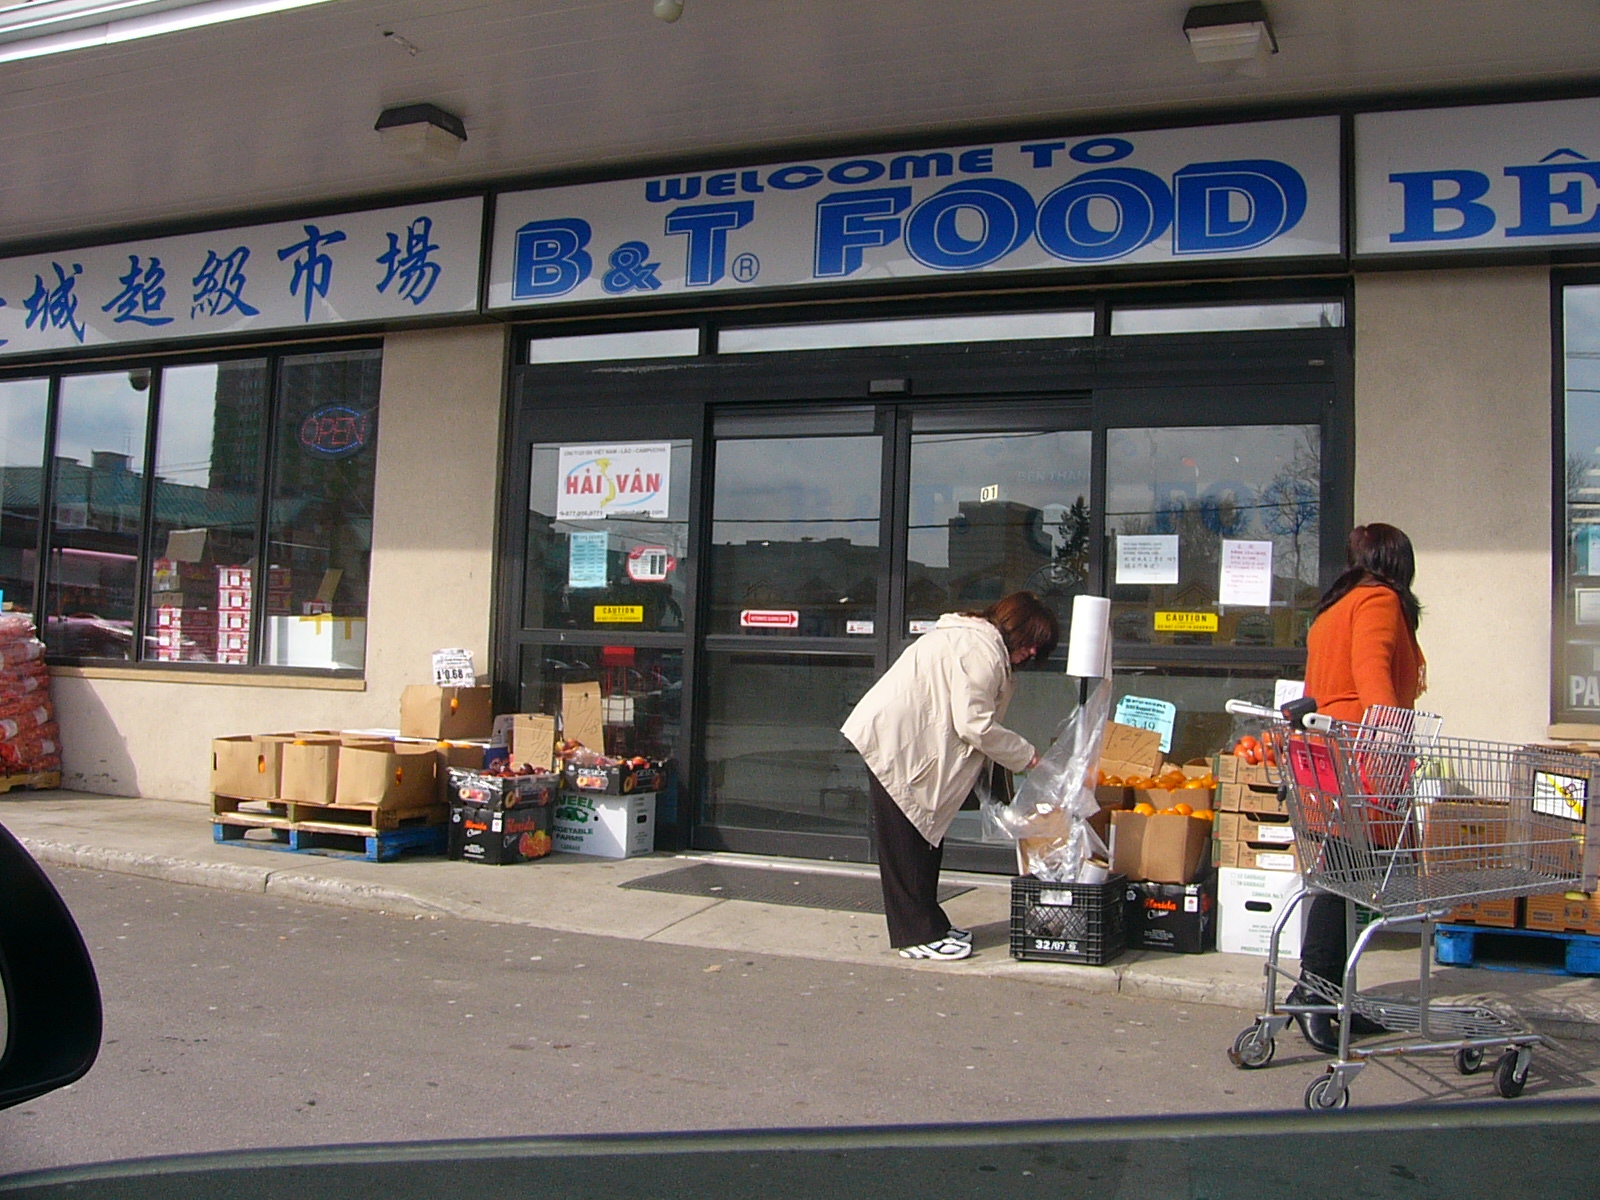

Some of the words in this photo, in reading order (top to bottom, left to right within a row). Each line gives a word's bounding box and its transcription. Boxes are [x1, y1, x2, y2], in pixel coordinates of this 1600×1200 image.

[645, 148, 993, 203] WELCOME
[1020, 138, 1134, 169] TO
[813, 159, 1308, 279] FOOD
[0, 216, 442, 347] 城超級市場
[301, 416, 368, 445] OPEN
[982, 486, 996, 501] 01
[1165, 613, 1207, 622] CAUTION
